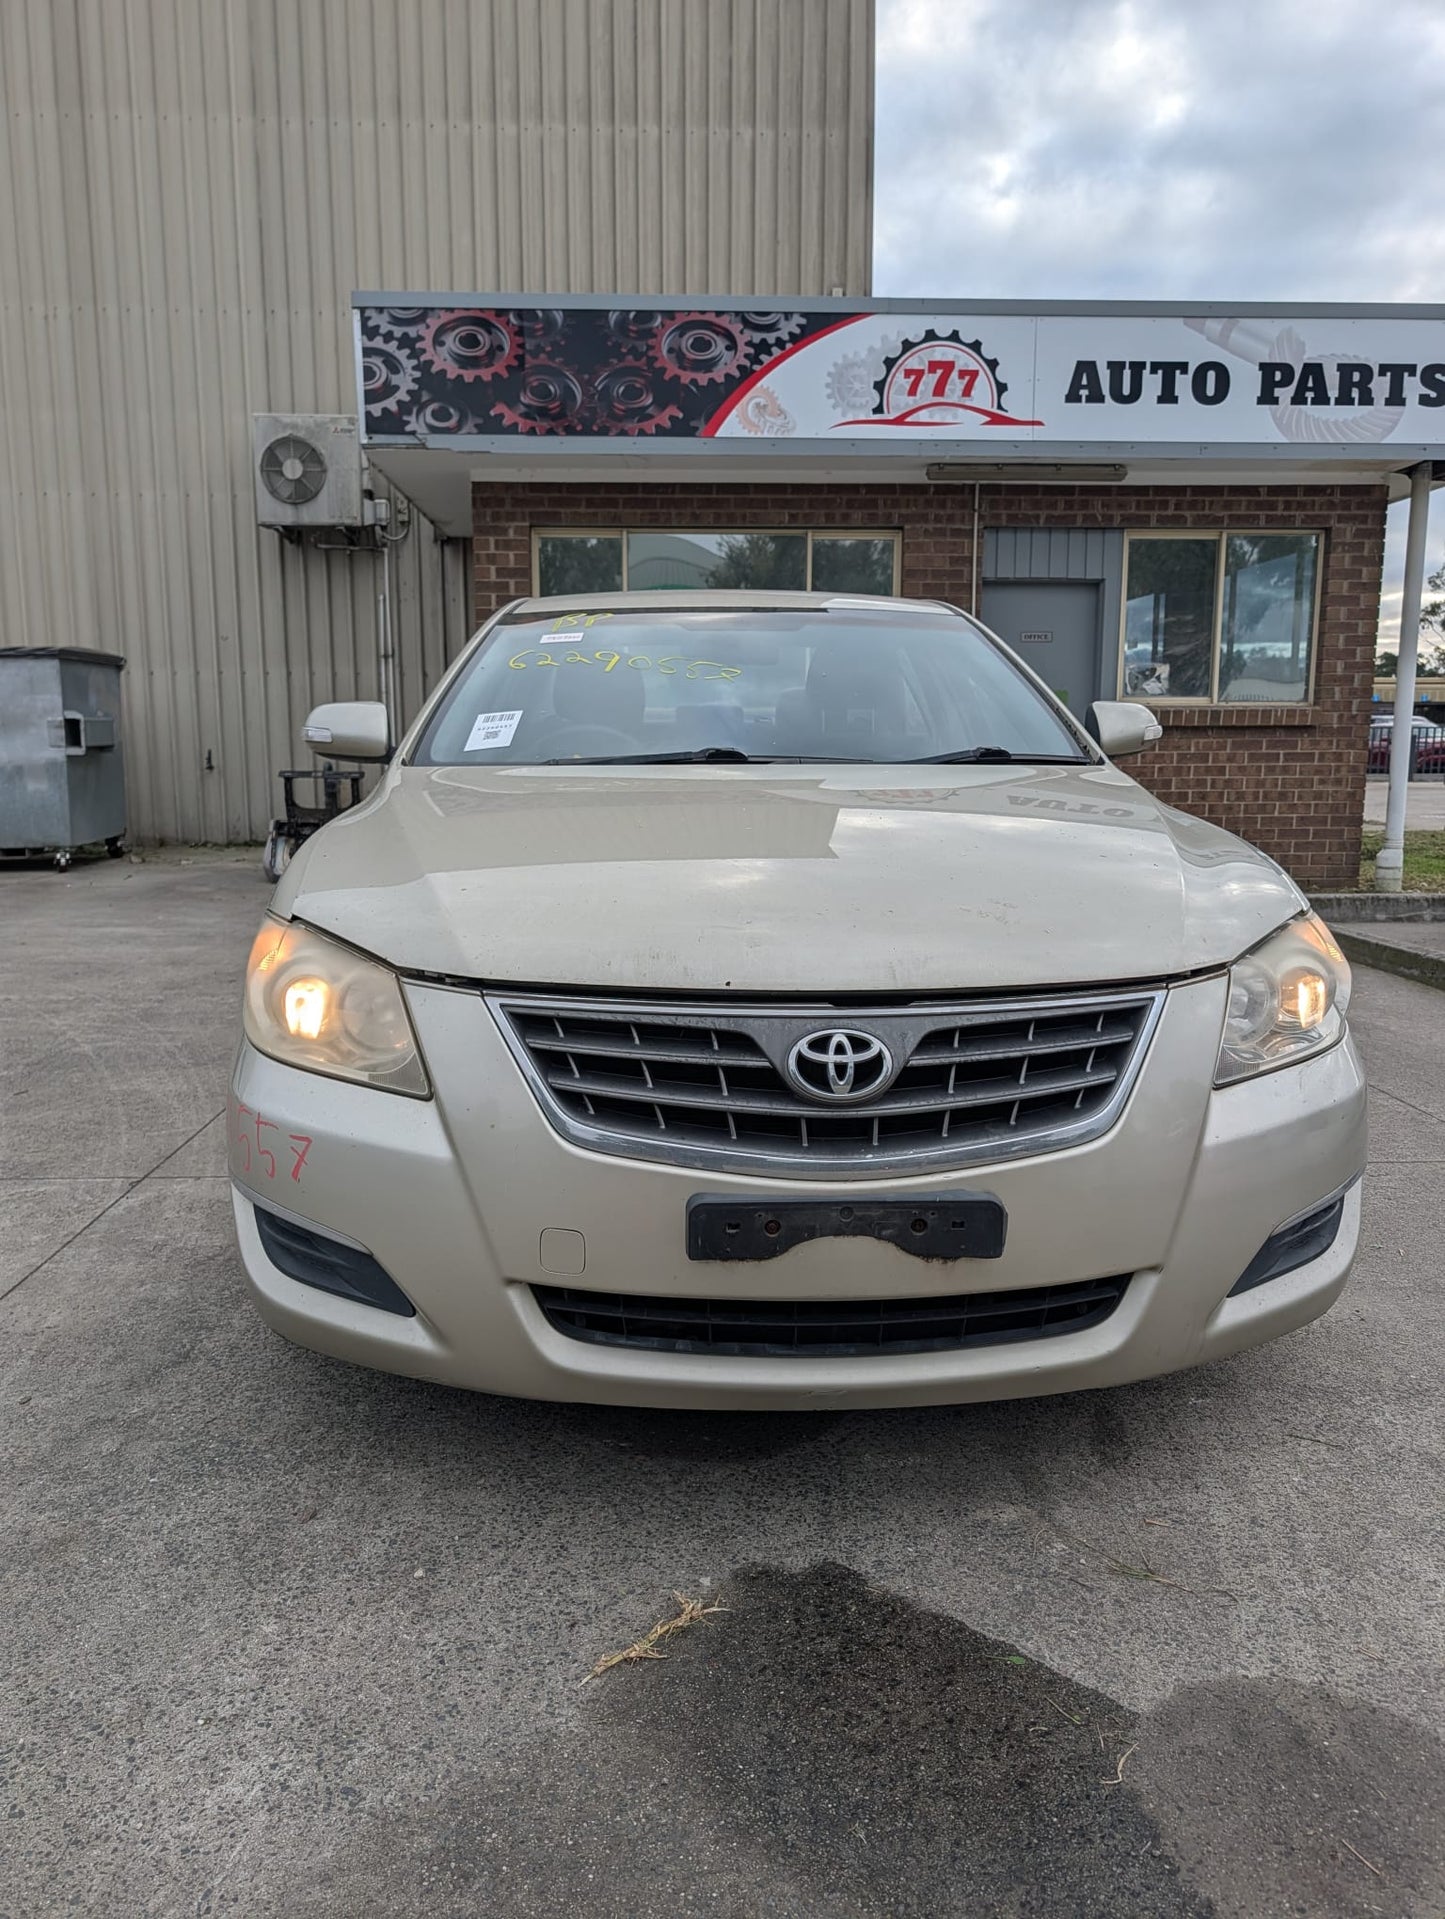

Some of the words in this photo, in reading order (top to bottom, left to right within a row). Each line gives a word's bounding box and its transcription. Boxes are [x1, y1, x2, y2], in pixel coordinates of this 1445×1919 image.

[904, 360, 980, 398] 777
[1064, 360, 1231, 406] AUTO
[1256, 362, 1445, 408] PARTS
[1023, 633, 1049, 641] OFFICE
